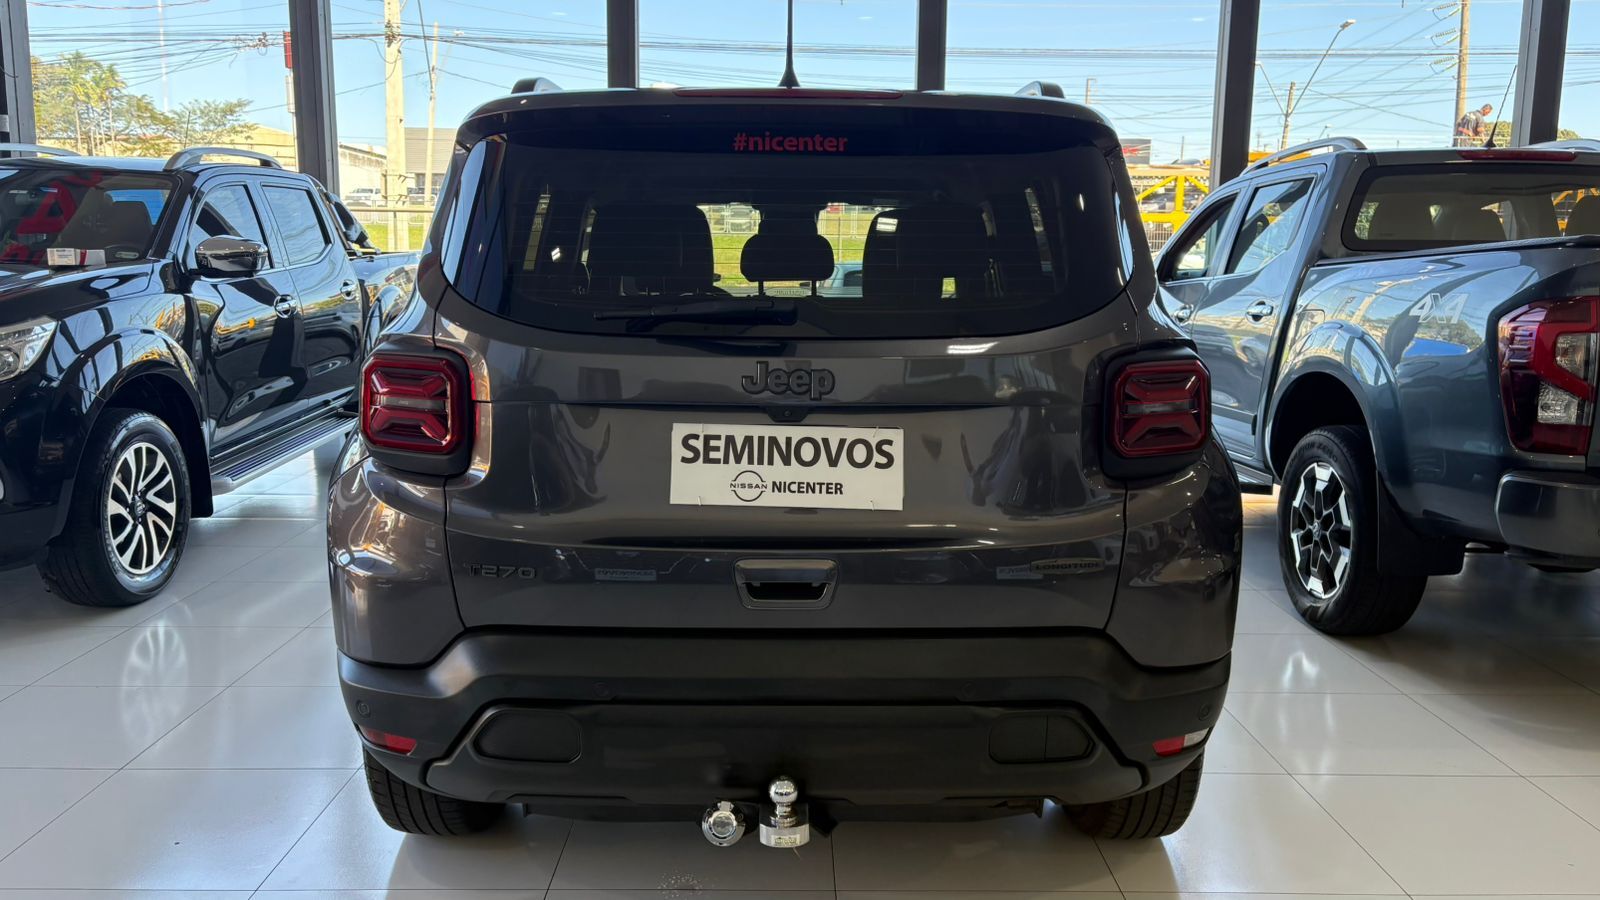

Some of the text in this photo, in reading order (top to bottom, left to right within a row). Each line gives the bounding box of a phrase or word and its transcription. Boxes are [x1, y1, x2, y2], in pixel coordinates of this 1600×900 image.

[733, 131, 848, 152] #nicenter
[742, 361, 836, 400] Jeep
[680, 433, 895, 470] SEMINOVOS
[729, 480, 844, 495] NISSAN NICENTER
[465, 563, 537, 580] T270
